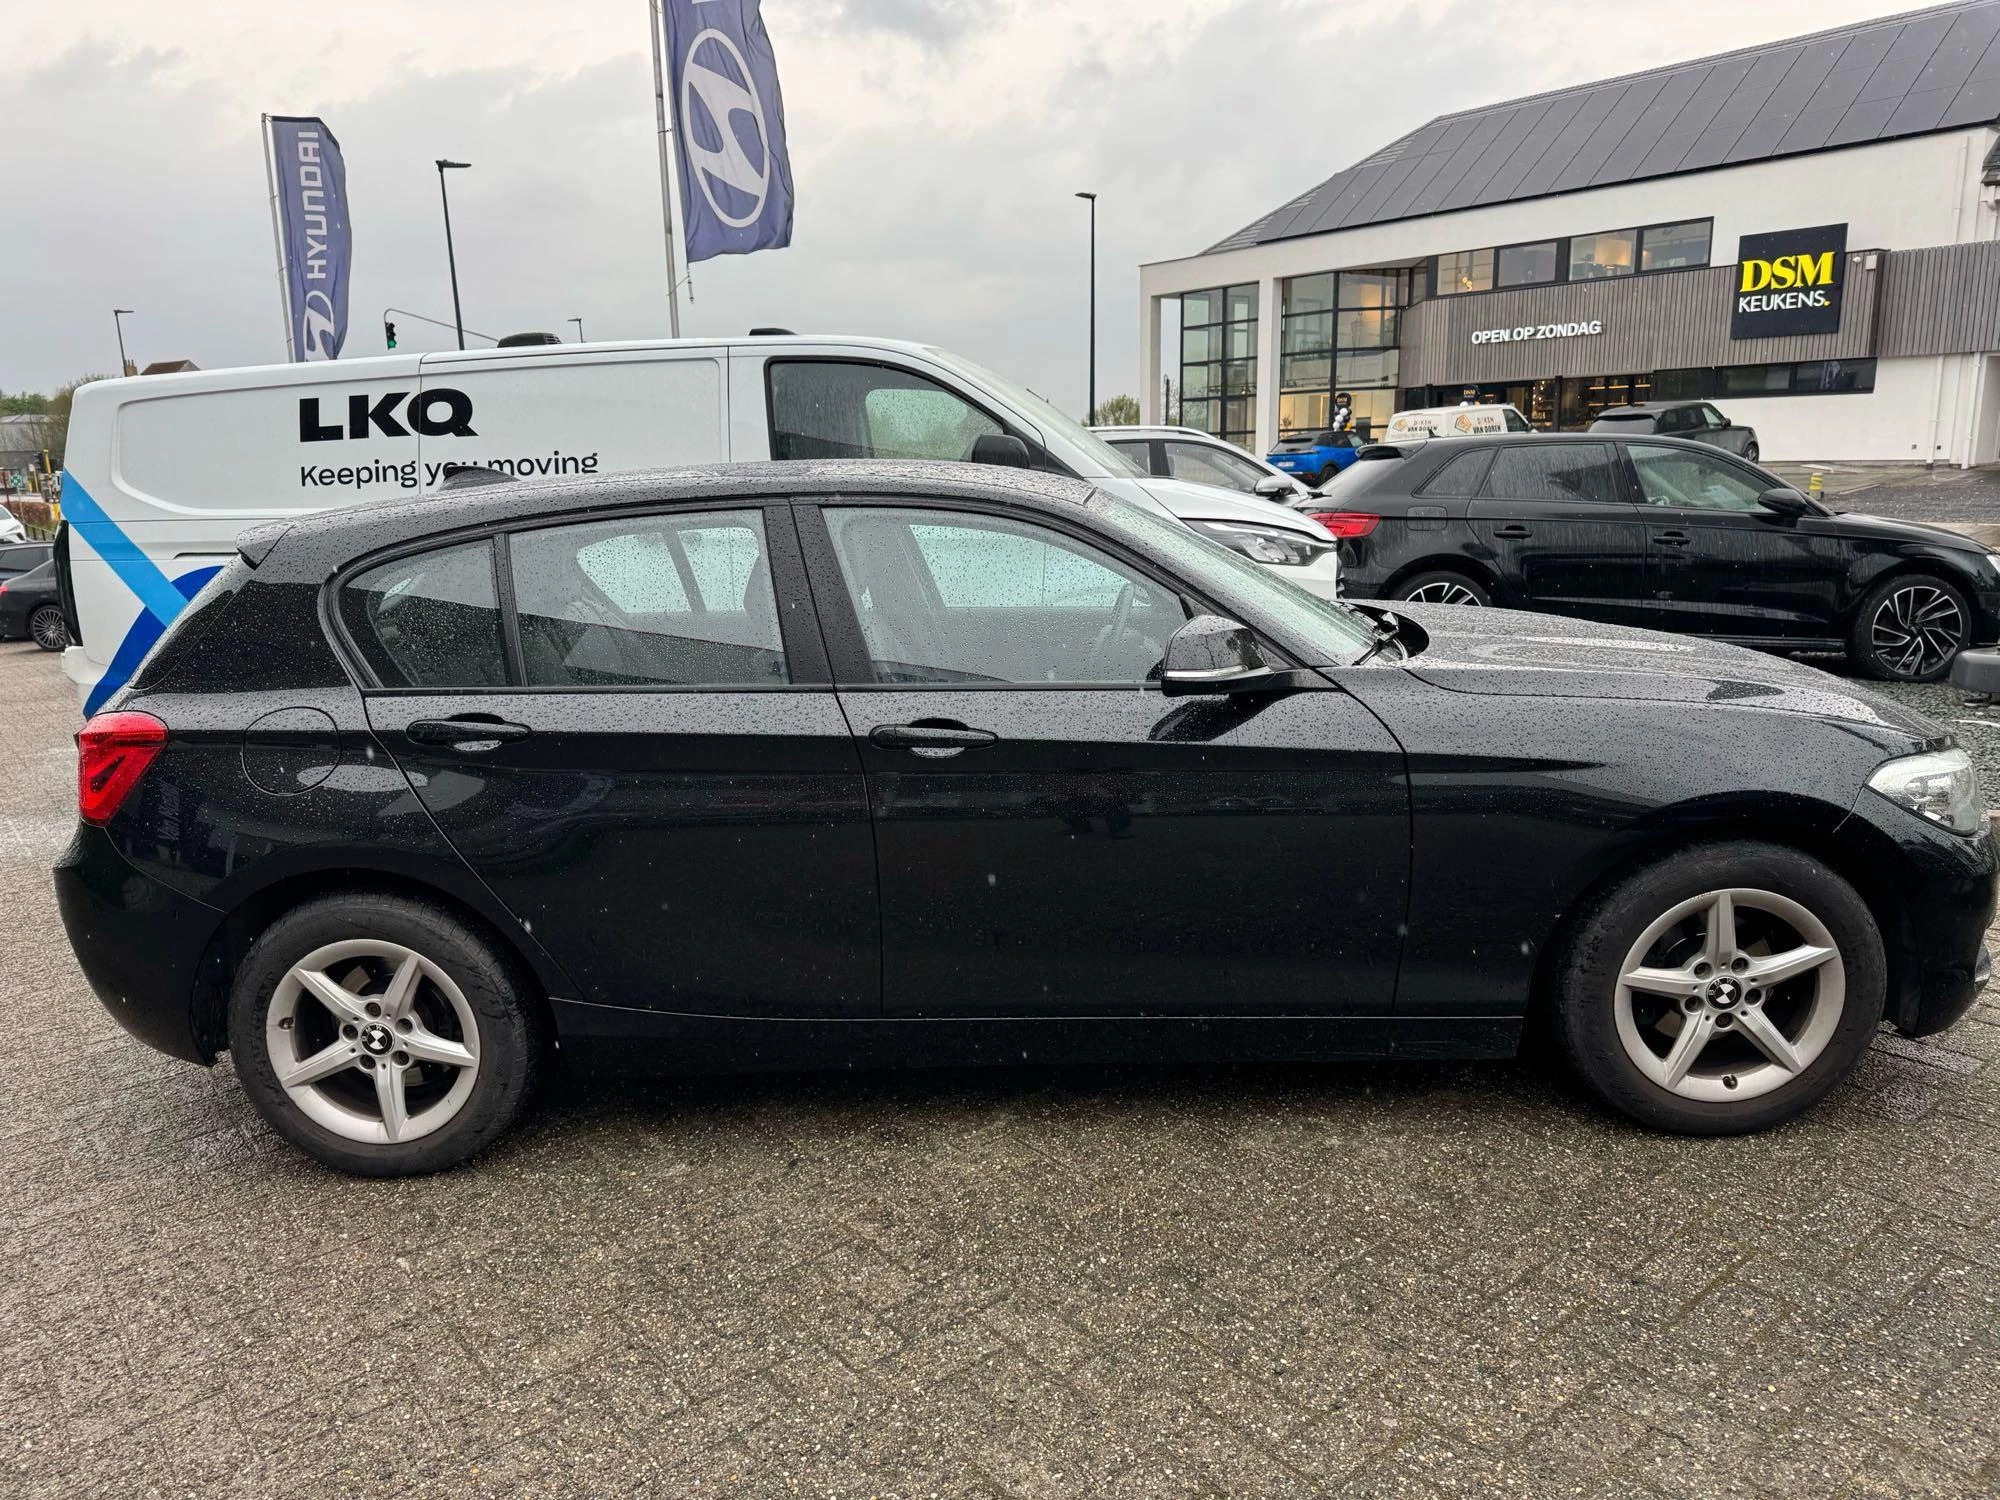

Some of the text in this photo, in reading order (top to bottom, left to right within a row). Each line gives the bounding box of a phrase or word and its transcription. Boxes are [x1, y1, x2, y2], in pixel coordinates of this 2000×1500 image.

[297, 131, 327, 280] HYUNDAI
[1739, 251, 1835, 292] DSM
[1738, 290, 1831, 313] KEUKENS.
[1471, 320, 1602, 345] OPEN OP ZONDAG
[299, 388, 479, 442] LKQ
[1472, 426, 1484, 434] VAN
[300, 459, 418, 489] Keeping
[487, 450, 599, 476] moving
